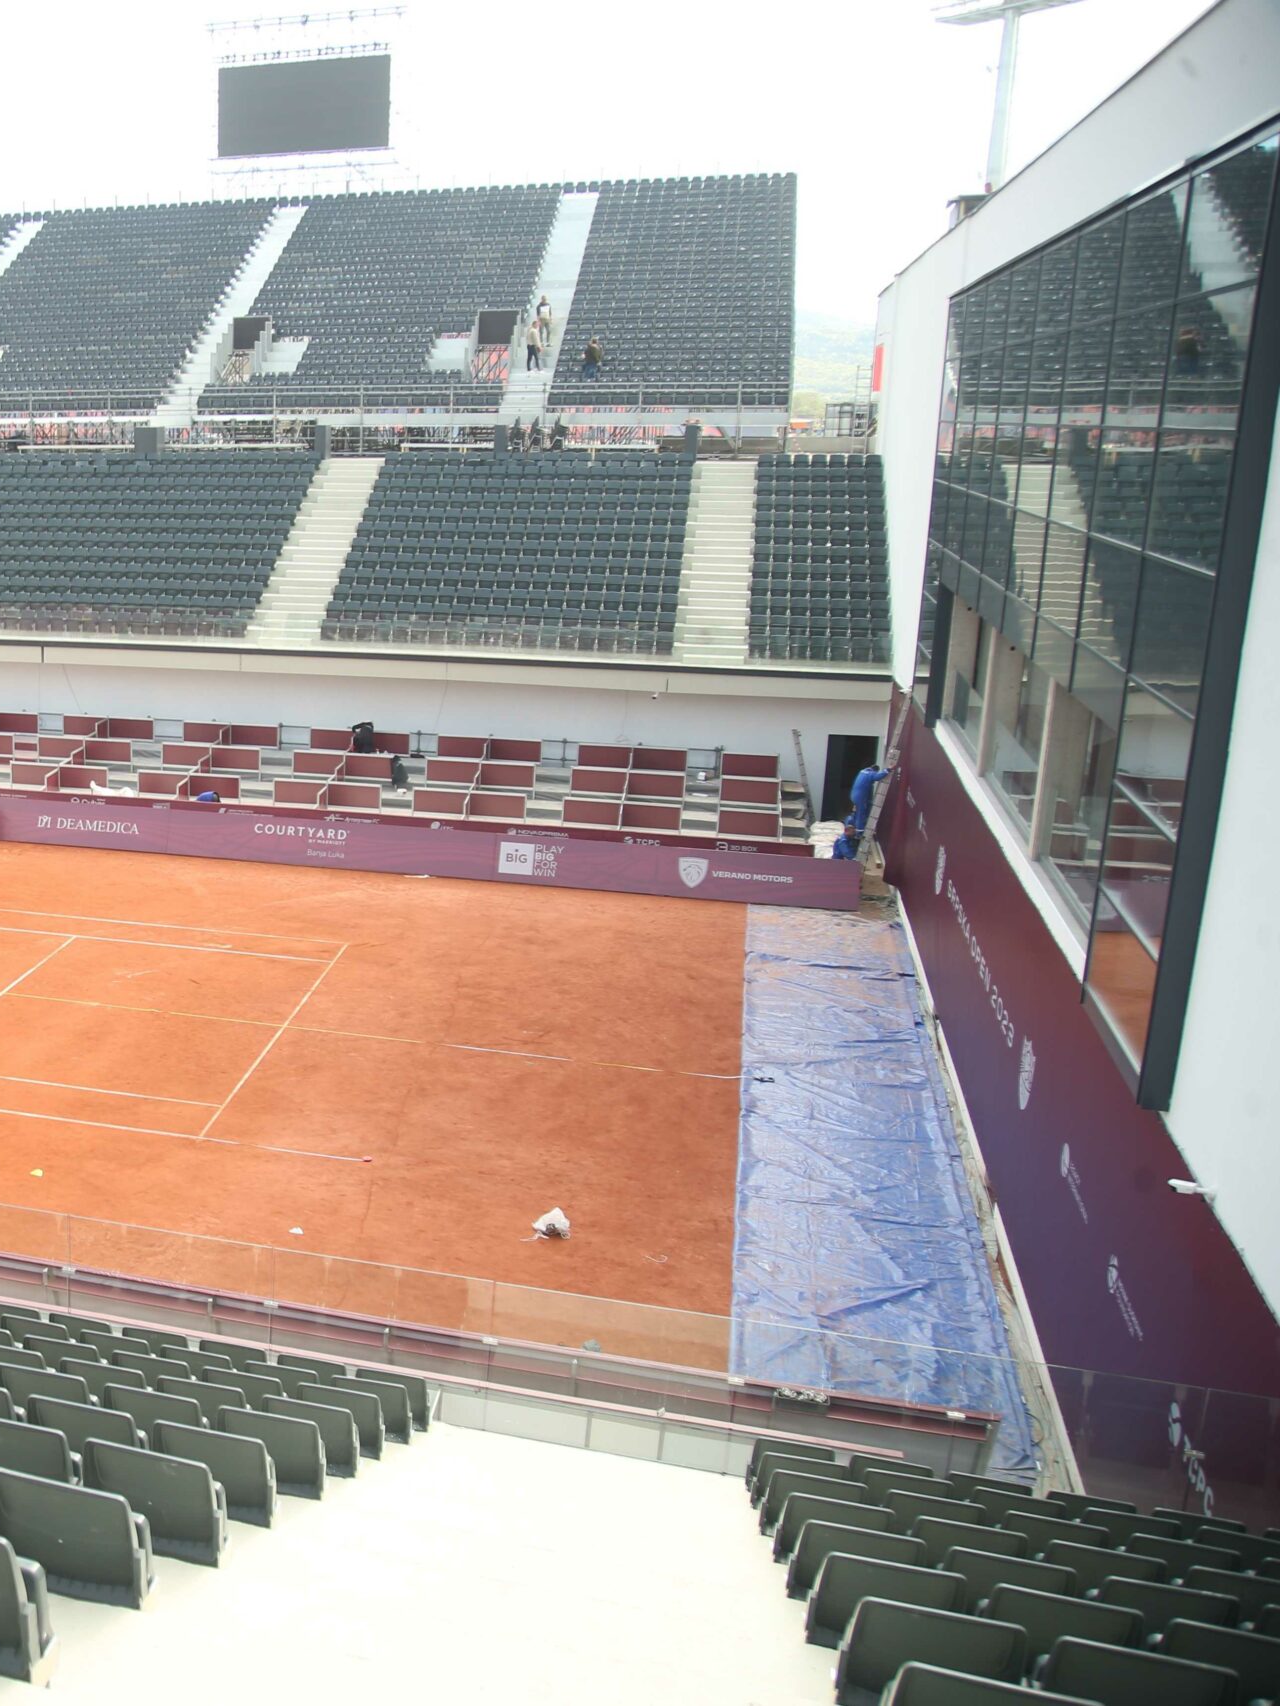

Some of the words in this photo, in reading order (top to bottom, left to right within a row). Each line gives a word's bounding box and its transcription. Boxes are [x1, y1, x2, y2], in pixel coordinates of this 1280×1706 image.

[56, 818, 140, 835] DEAMEDICA
[254, 823, 348, 840] COURTYARD
[635, 838, 661, 847] TCPC
[307, 849, 327, 858] Banja
[328, 850, 345, 859] Luka
[535, 844, 565, 854] PLAY
[535, 852, 555, 862] BIG
[534, 860, 557, 870] FOR
[533, 869, 555, 877] WIN
[712, 870, 752, 881] VERANO
[753, 873, 793, 884] MOTORS
[947, 879, 971, 945] SRPSKA
[971, 935, 991, 993] OPEN
[991, 985, 1015, 1048] 2023
